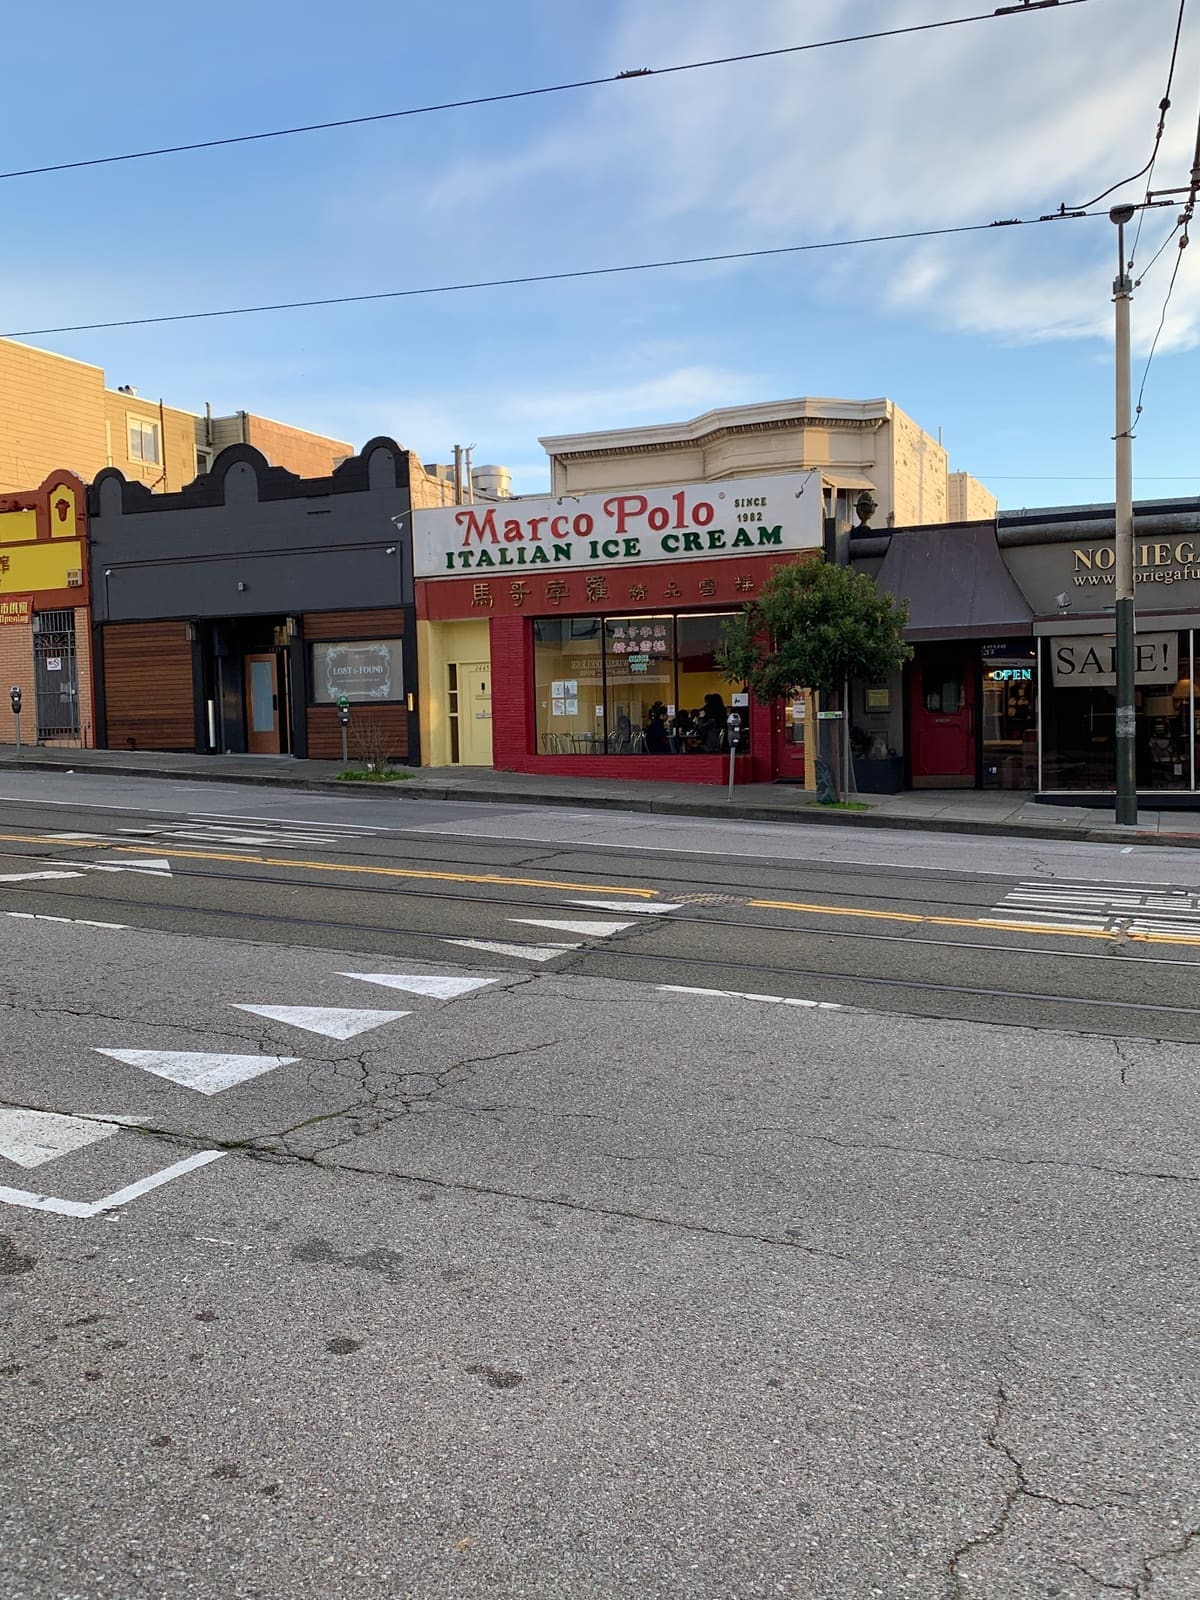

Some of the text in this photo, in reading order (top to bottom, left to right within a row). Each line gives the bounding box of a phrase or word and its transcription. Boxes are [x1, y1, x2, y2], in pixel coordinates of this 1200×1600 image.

[734, 497, 767, 508] SINCE
[455, 491, 714, 546] Marco Polo
[737, 512, 763, 523] 1982
[446, 525, 783, 569] ITALIAN ICE CREAM
[1073, 542, 1200, 571] NOIEG
[333, 666, 352, 675] LOST
[359, 665, 383, 674] FOUND
[992, 669, 1032, 681] OPEN
